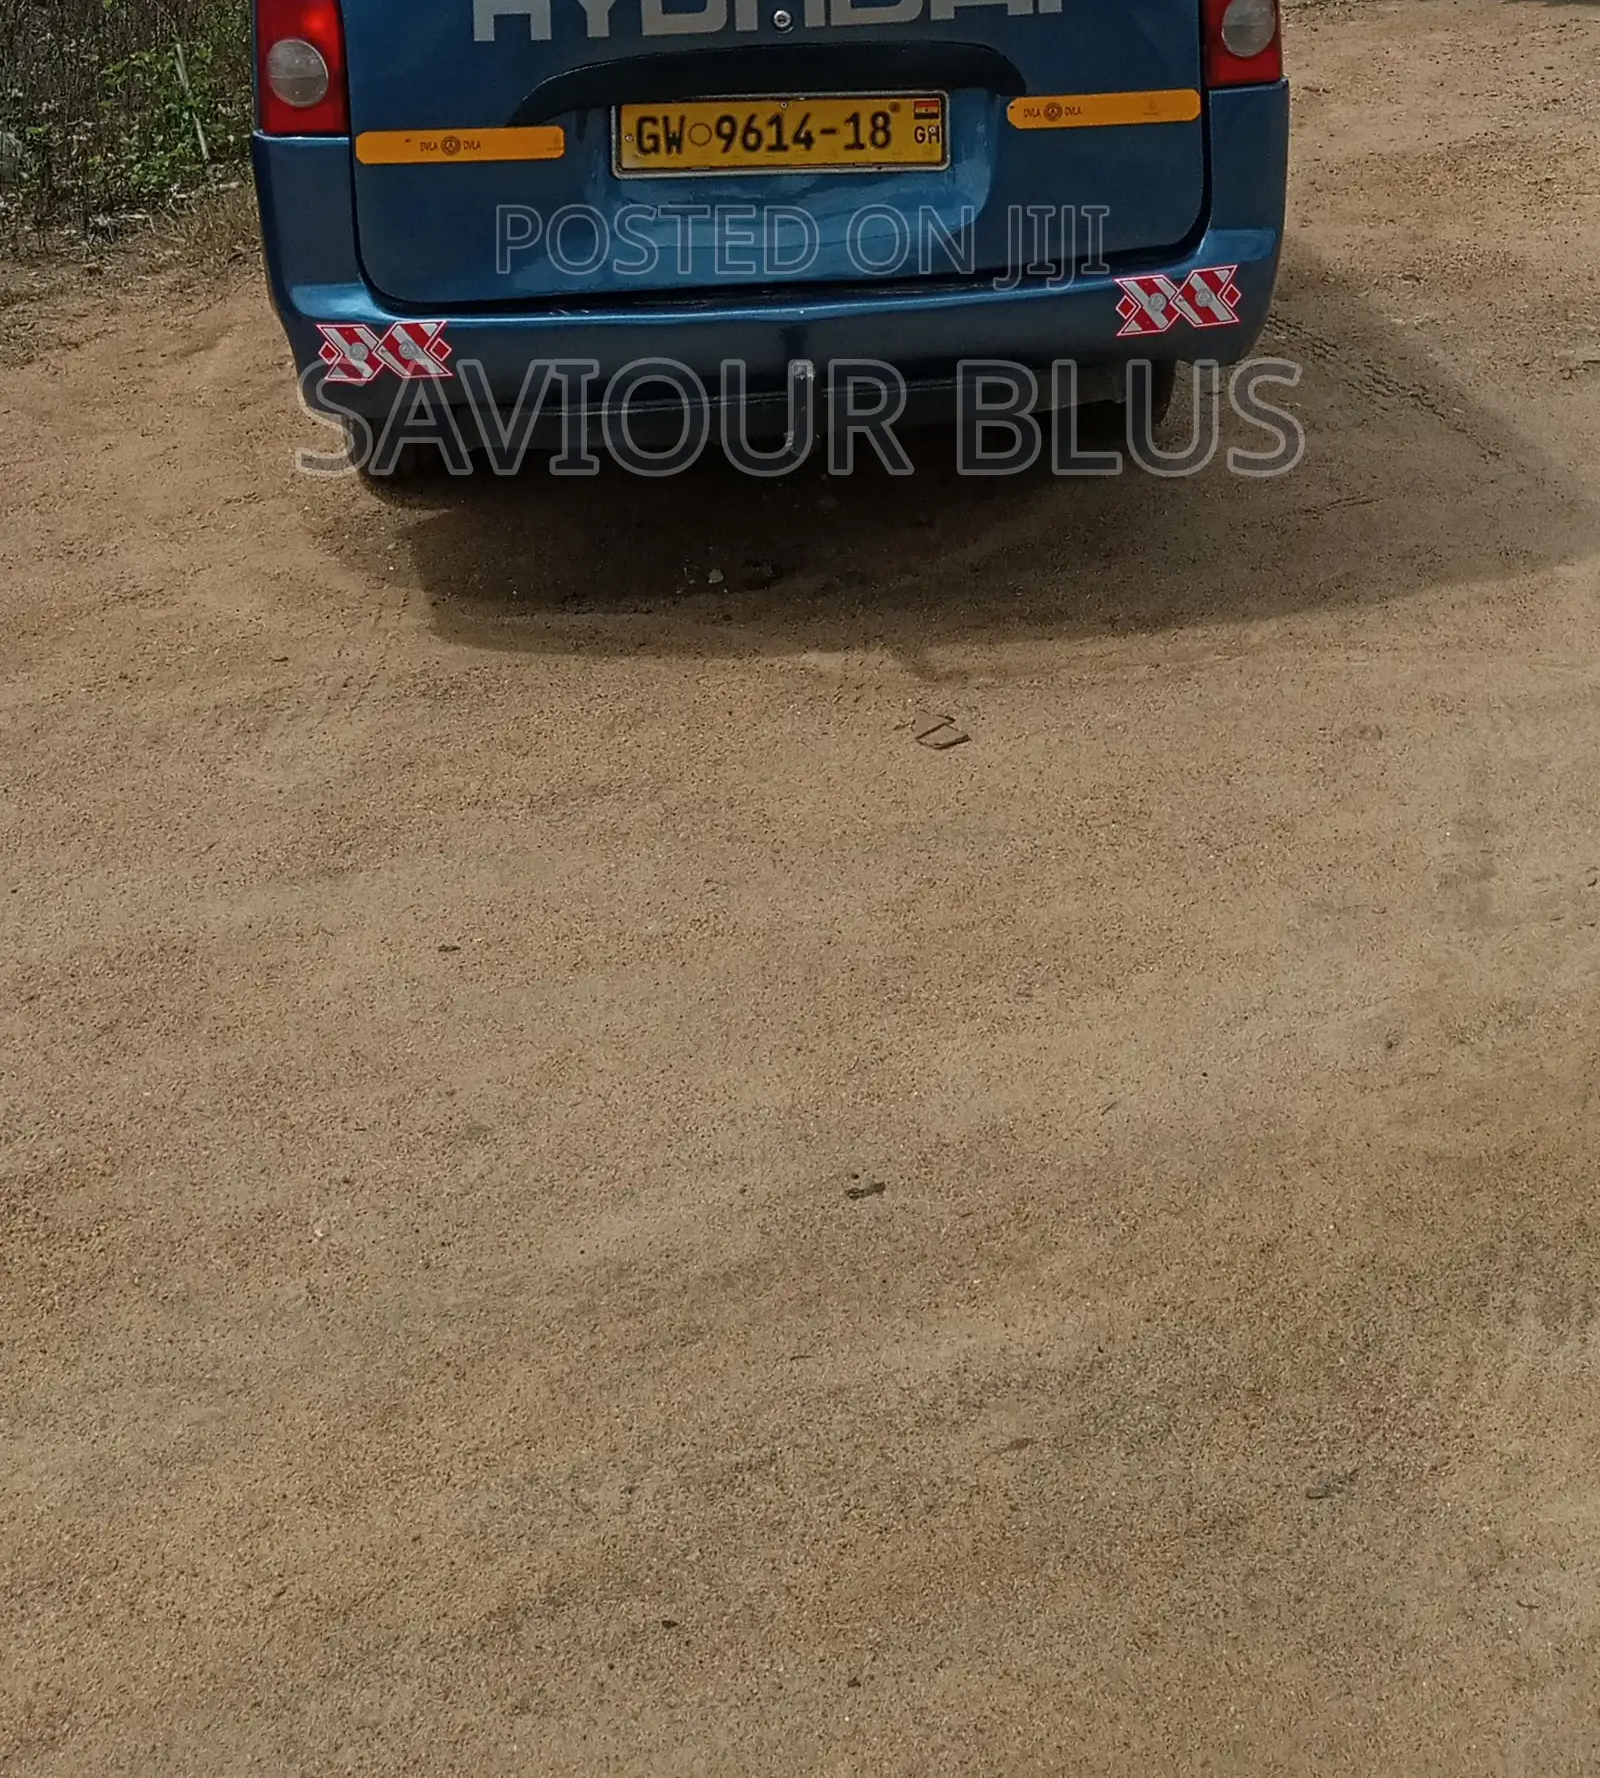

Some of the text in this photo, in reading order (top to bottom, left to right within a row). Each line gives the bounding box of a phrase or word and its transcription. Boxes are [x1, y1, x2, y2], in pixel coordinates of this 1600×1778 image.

[1023, 107, 1041, 119] DVLA
[1064, 106, 1082, 117] DVLA
[635, 110, 893, 155] GW 9614-18
[914, 124, 940, 145] GH
[420, 141, 439, 152] DVLA
[463, 140, 482, 151] DVLA
